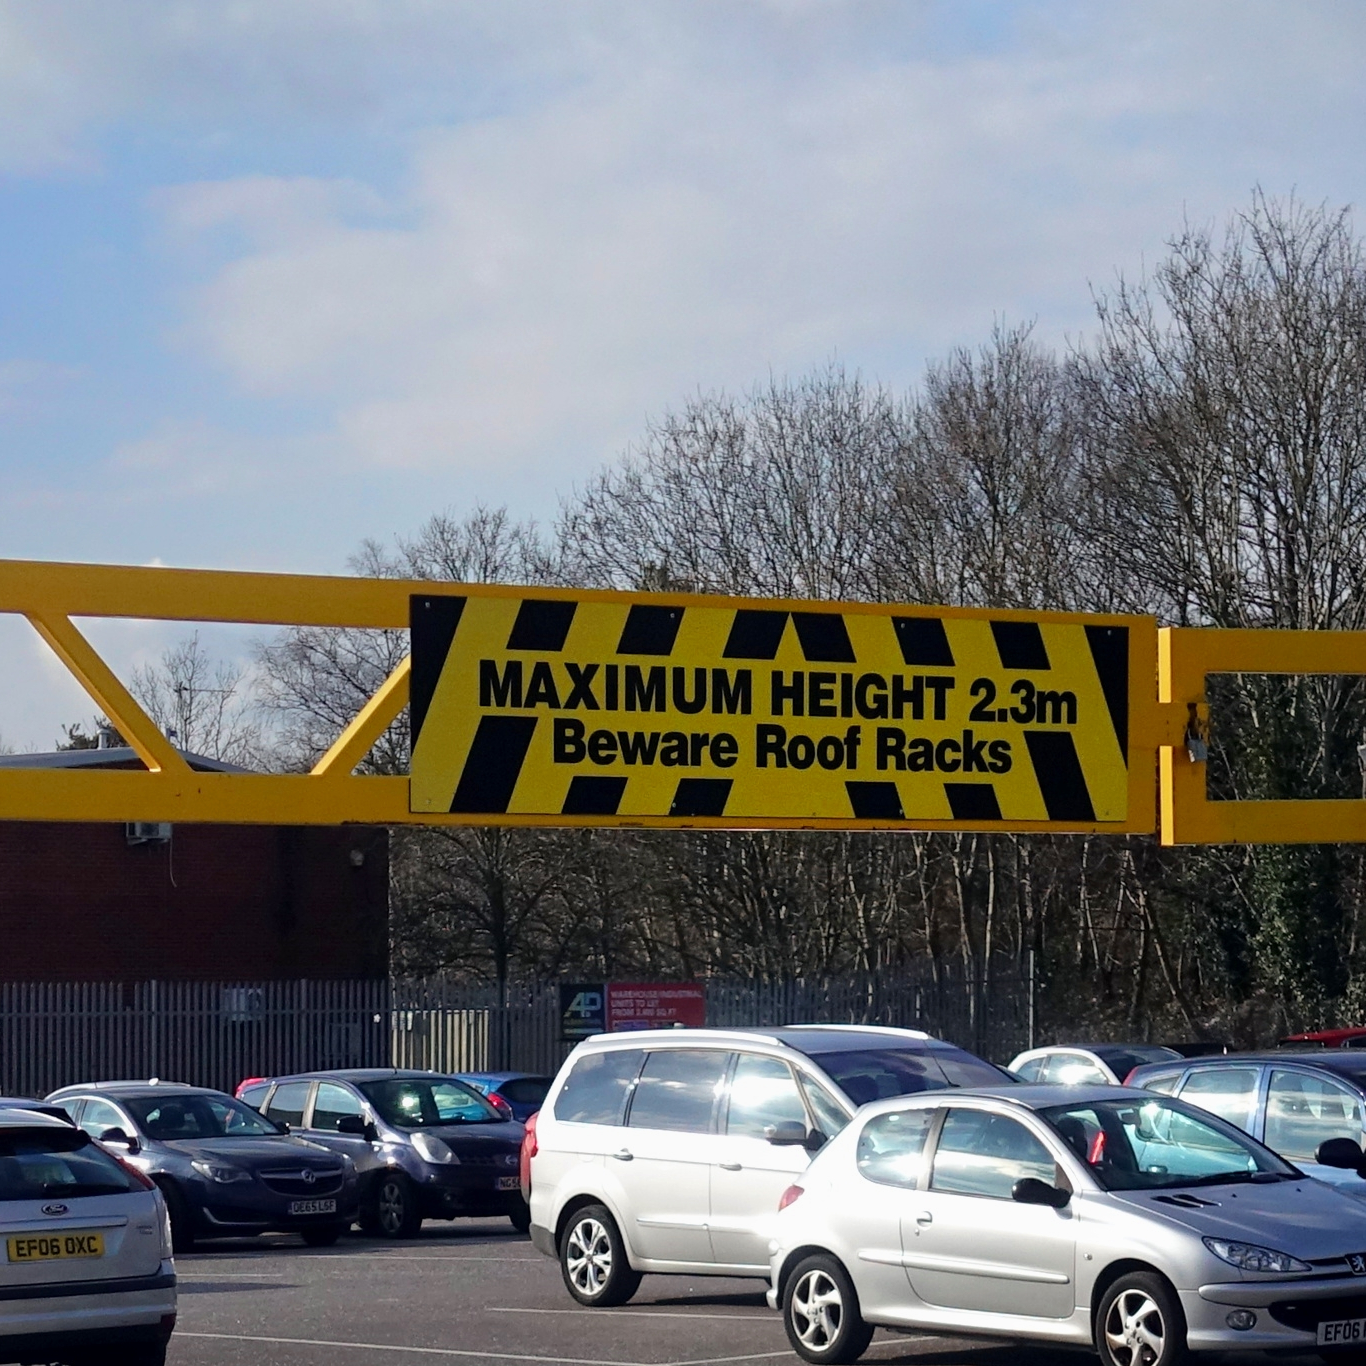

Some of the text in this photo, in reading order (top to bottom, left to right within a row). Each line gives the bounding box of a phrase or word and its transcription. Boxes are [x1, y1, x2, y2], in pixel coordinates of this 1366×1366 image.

[479, 659, 1078, 725] MAXIMUM HEIGHT 2.3m
[553, 717, 1012, 774] Beware Roof Racks
[15, 1236, 98, 1258] EF06 OXC
[1324, 1321, 1360, 1342] EF06
